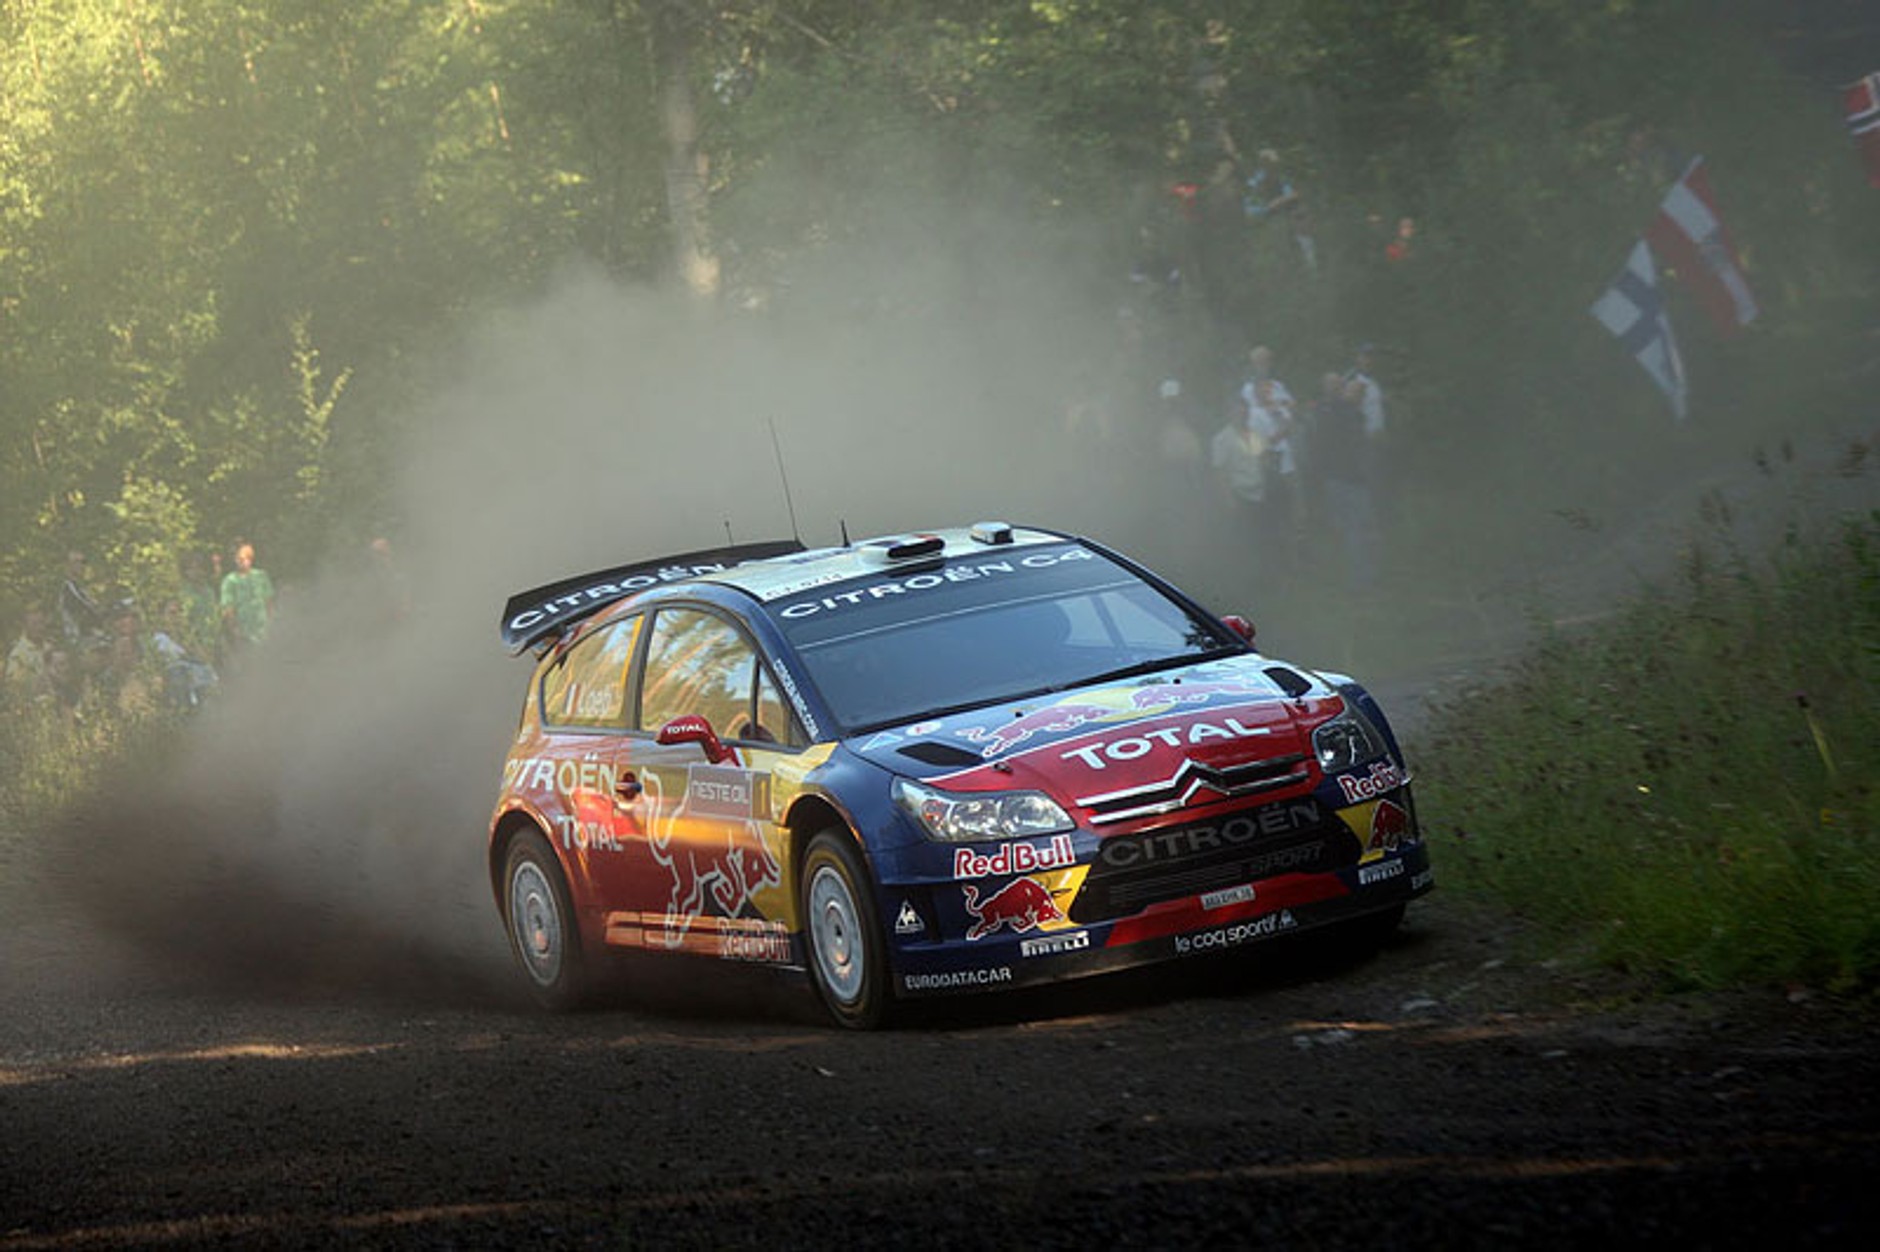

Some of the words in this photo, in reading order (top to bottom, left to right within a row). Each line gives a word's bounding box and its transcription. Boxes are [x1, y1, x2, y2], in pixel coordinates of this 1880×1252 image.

[510, 562, 728, 630] CITROËN
[781, 562, 1015, 619] CITROËN
[1020, 548, 1094, 568] C4
[666, 723, 704, 735] TOTAL
[1062, 718, 1271, 770] TOTAL
[1336, 762, 1384, 803] Red
[556, 815, 624, 852] TOTAL
[1102, 802, 1322, 867] CITROËN
[953, 844, 1010, 880] Red
[1013, 834, 1076, 873] Bull
[1020, 930, 1090, 958] PIRELLI
[1192, 923, 1228, 952] coq
[1227, 912, 1279, 947] sportif
[904, 967, 1013, 990] EURODATACAR
